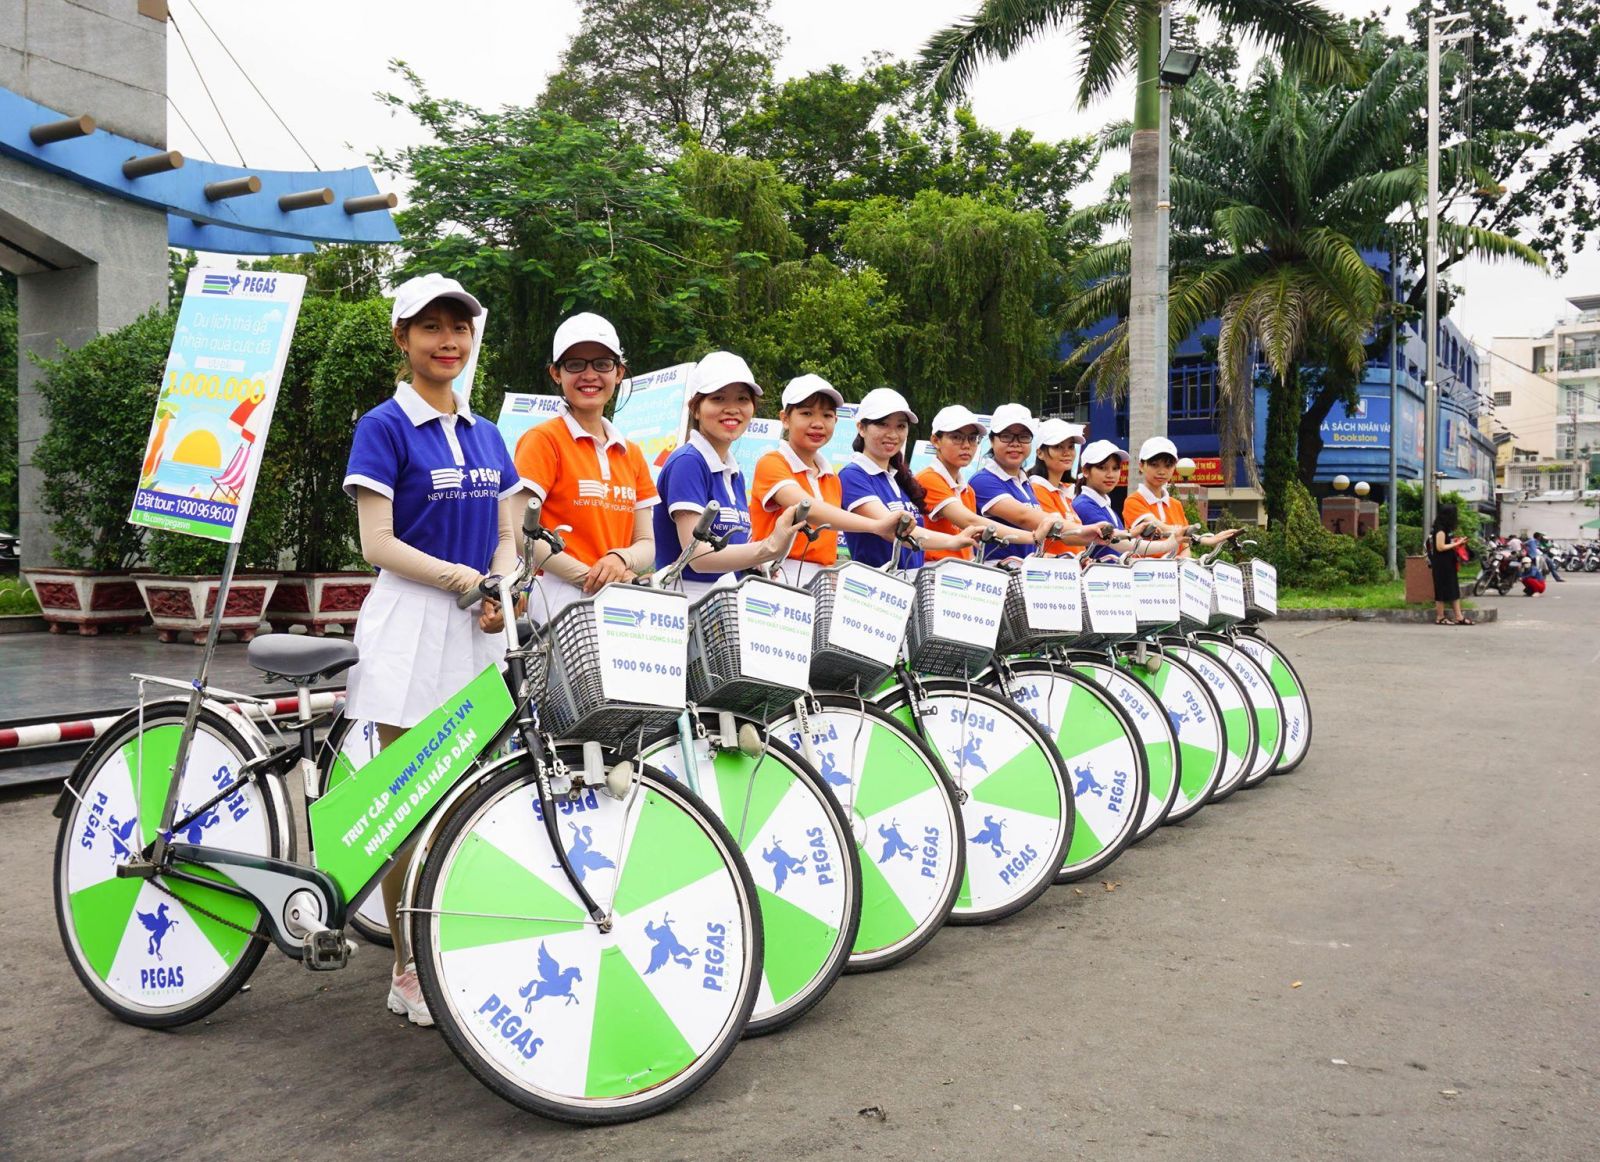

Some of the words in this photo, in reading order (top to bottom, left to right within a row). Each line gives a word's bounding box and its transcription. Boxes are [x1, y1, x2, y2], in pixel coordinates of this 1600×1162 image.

[242, 276, 277, 294] PEGAS
[168, 370, 265, 405] 1.000.000
[655, 369, 678, 385] PEGAS
[745, 422, 769, 434] EGAS
[1331, 418, 1357, 432] SÁCH
[1333, 432, 1378, 443] Bookstore
[137, 491, 154, 511] Đặt
[176, 499, 198, 516] 1900
[197, 503, 209, 518] 96
[209, 505, 222, 520] 96
[221, 507, 235, 522] 00
[427, 492, 444, 501] NEW
[469, 489, 489, 498] YOUR
[712, 523, 728, 531] NEW
[1054, 570, 1077, 581] PEGAS
[1112, 581, 1131, 590] PEGAS
[1157, 571, 1176, 579] PEGAS
[879, 590, 908, 610] PEGAS
[975, 582, 1002, 597] PEGAS
[783, 606, 812, 625] PEGAS
[942, 608, 960, 620] 1900
[962, 612, 973, 622] 96
[974, 615, 984, 625] 96
[985, 617, 996, 627] 00
[1032, 602, 1048, 610] 1900
[1058, 603, 1067, 611] 96
[1067, 603, 1076, 611] 00
[650, 612, 685, 630] PEGAS
[842, 615, 861, 630] 1900
[862, 623, 873, 634] 96
[874, 628, 886, 639] 96
[886, 632, 897, 643] 00
[750, 641, 770, 655] 1900
[772, 647, 784, 658] 96
[784, 649, 796, 661] 96
[797, 653, 807, 664] 00
[612, 658, 637, 671] 1900
[639, 661, 652, 673] 96
[654, 663, 667, 675] 96
[669, 665, 682, 677] 00
[1199, 663, 1225, 690] PEGAS
[1234, 662, 1258, 689] PEGAS
[1118, 687, 1150, 721] PEGAS
[1182, 690, 1206, 724] PEGAS
[798, 702, 810, 735] ASAMA
[950, 708, 996, 733] PEGAS
[1290, 717, 1300, 742] PEGAS
[341, 813, 371, 848] TRUY
[368, 790, 391, 820] CẬP
[388, 698, 475, 796] WWW.PEGAST.VN
[1107, 769, 1128, 813] PEGAS
[81, 791, 108, 850] PEGAS
[363, 817, 398, 857] NHẬN
[806, 826, 834, 886] PEGAS
[920, 826, 940, 879] PEGAS
[998, 843, 1038, 886] PEGAS
[703, 921, 726, 992] PEGAS
[140, 965, 184, 989] PEGAS
[477, 992, 545, 1060] PEGAS
